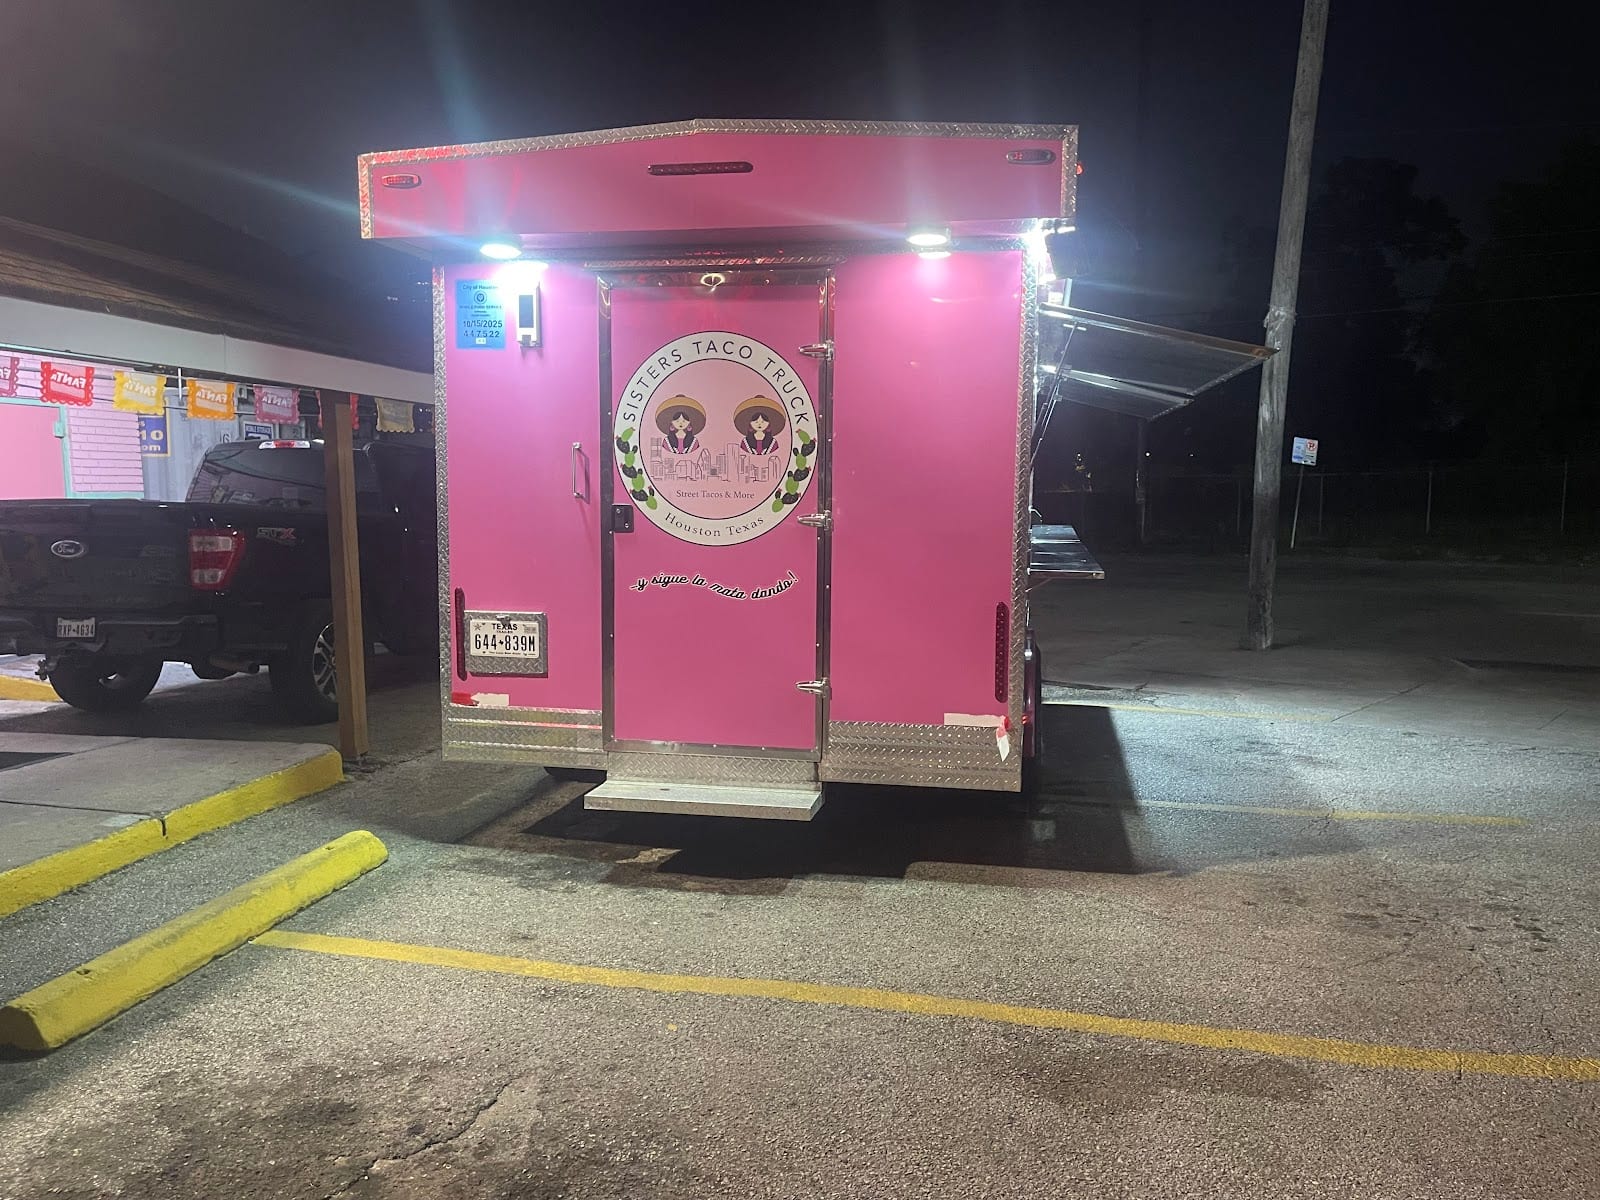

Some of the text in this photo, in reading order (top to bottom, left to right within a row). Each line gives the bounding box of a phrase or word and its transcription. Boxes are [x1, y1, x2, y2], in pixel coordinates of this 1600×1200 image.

[463, 320, 503, 328] 10/15/2025
[623, 340, 809, 425] SISTERS TACO TRUCK
[676, 490, 755, 499] Street Tacos & More
[665, 512, 764, 537] Houston Texas
[256, 527, 297, 539] STX
[650, 571, 690, 588] sigue
[691, 574, 708, 587] la
[708, 582, 748, 601] mata
[750, 568, 799, 601] dando!
[492, 623, 518, 631] TEXAS
